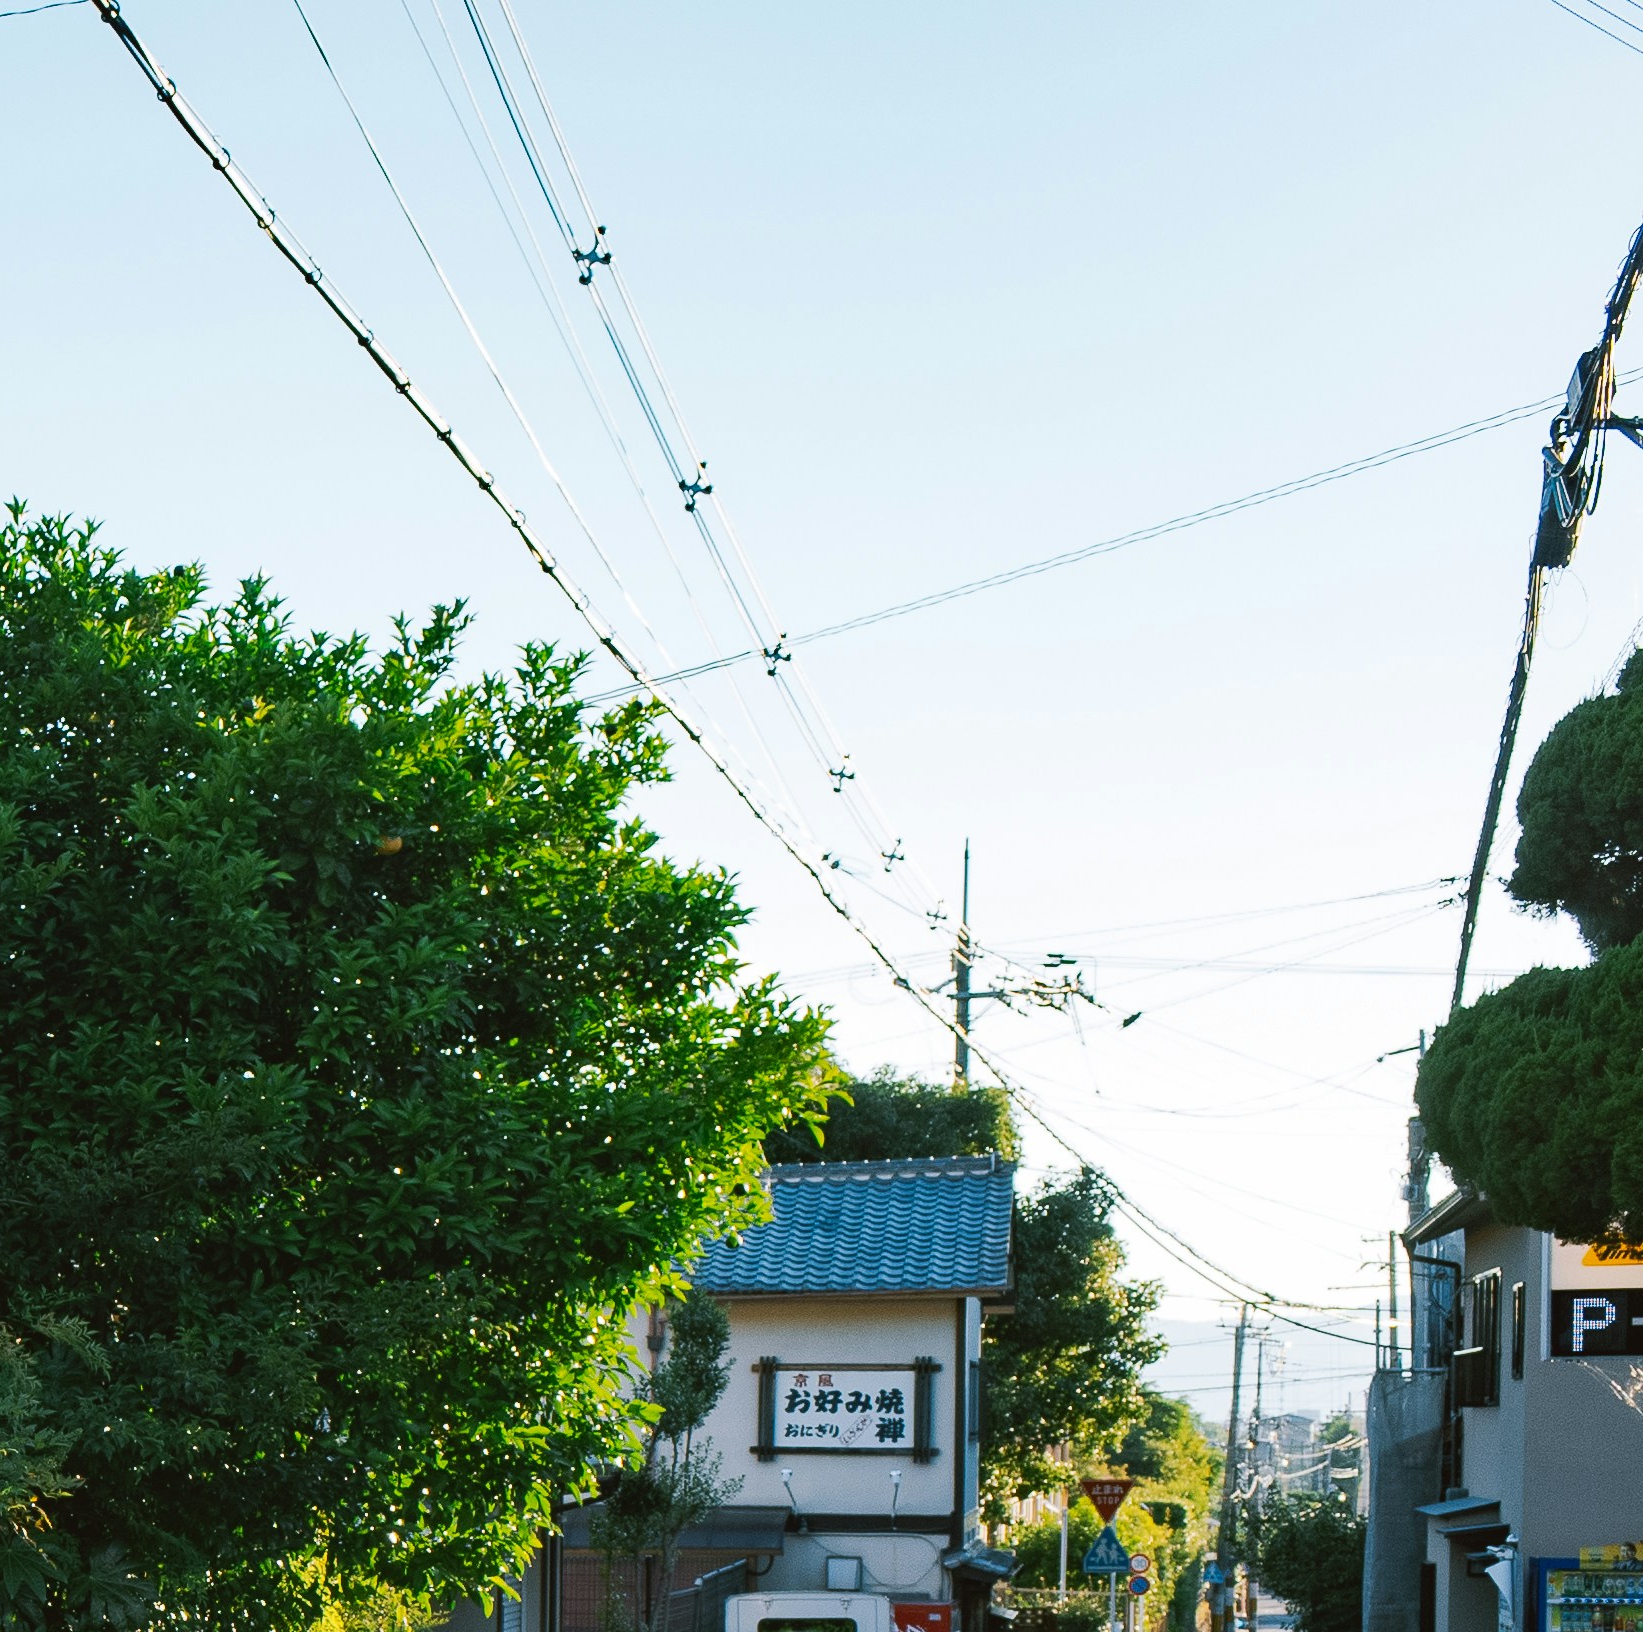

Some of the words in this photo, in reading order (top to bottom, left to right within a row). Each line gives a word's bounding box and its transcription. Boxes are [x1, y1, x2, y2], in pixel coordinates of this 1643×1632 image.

[1573, 1298, 1615, 1351] P
[793, 1374, 834, 1388] 京風
[784, 1388, 905, 1415] お好み焼
[784, 1423, 840, 1438] おにぎり
[1092, 1484, 1124, 1495] 止まれ
[1096, 1496, 1120, 1505] STOP
